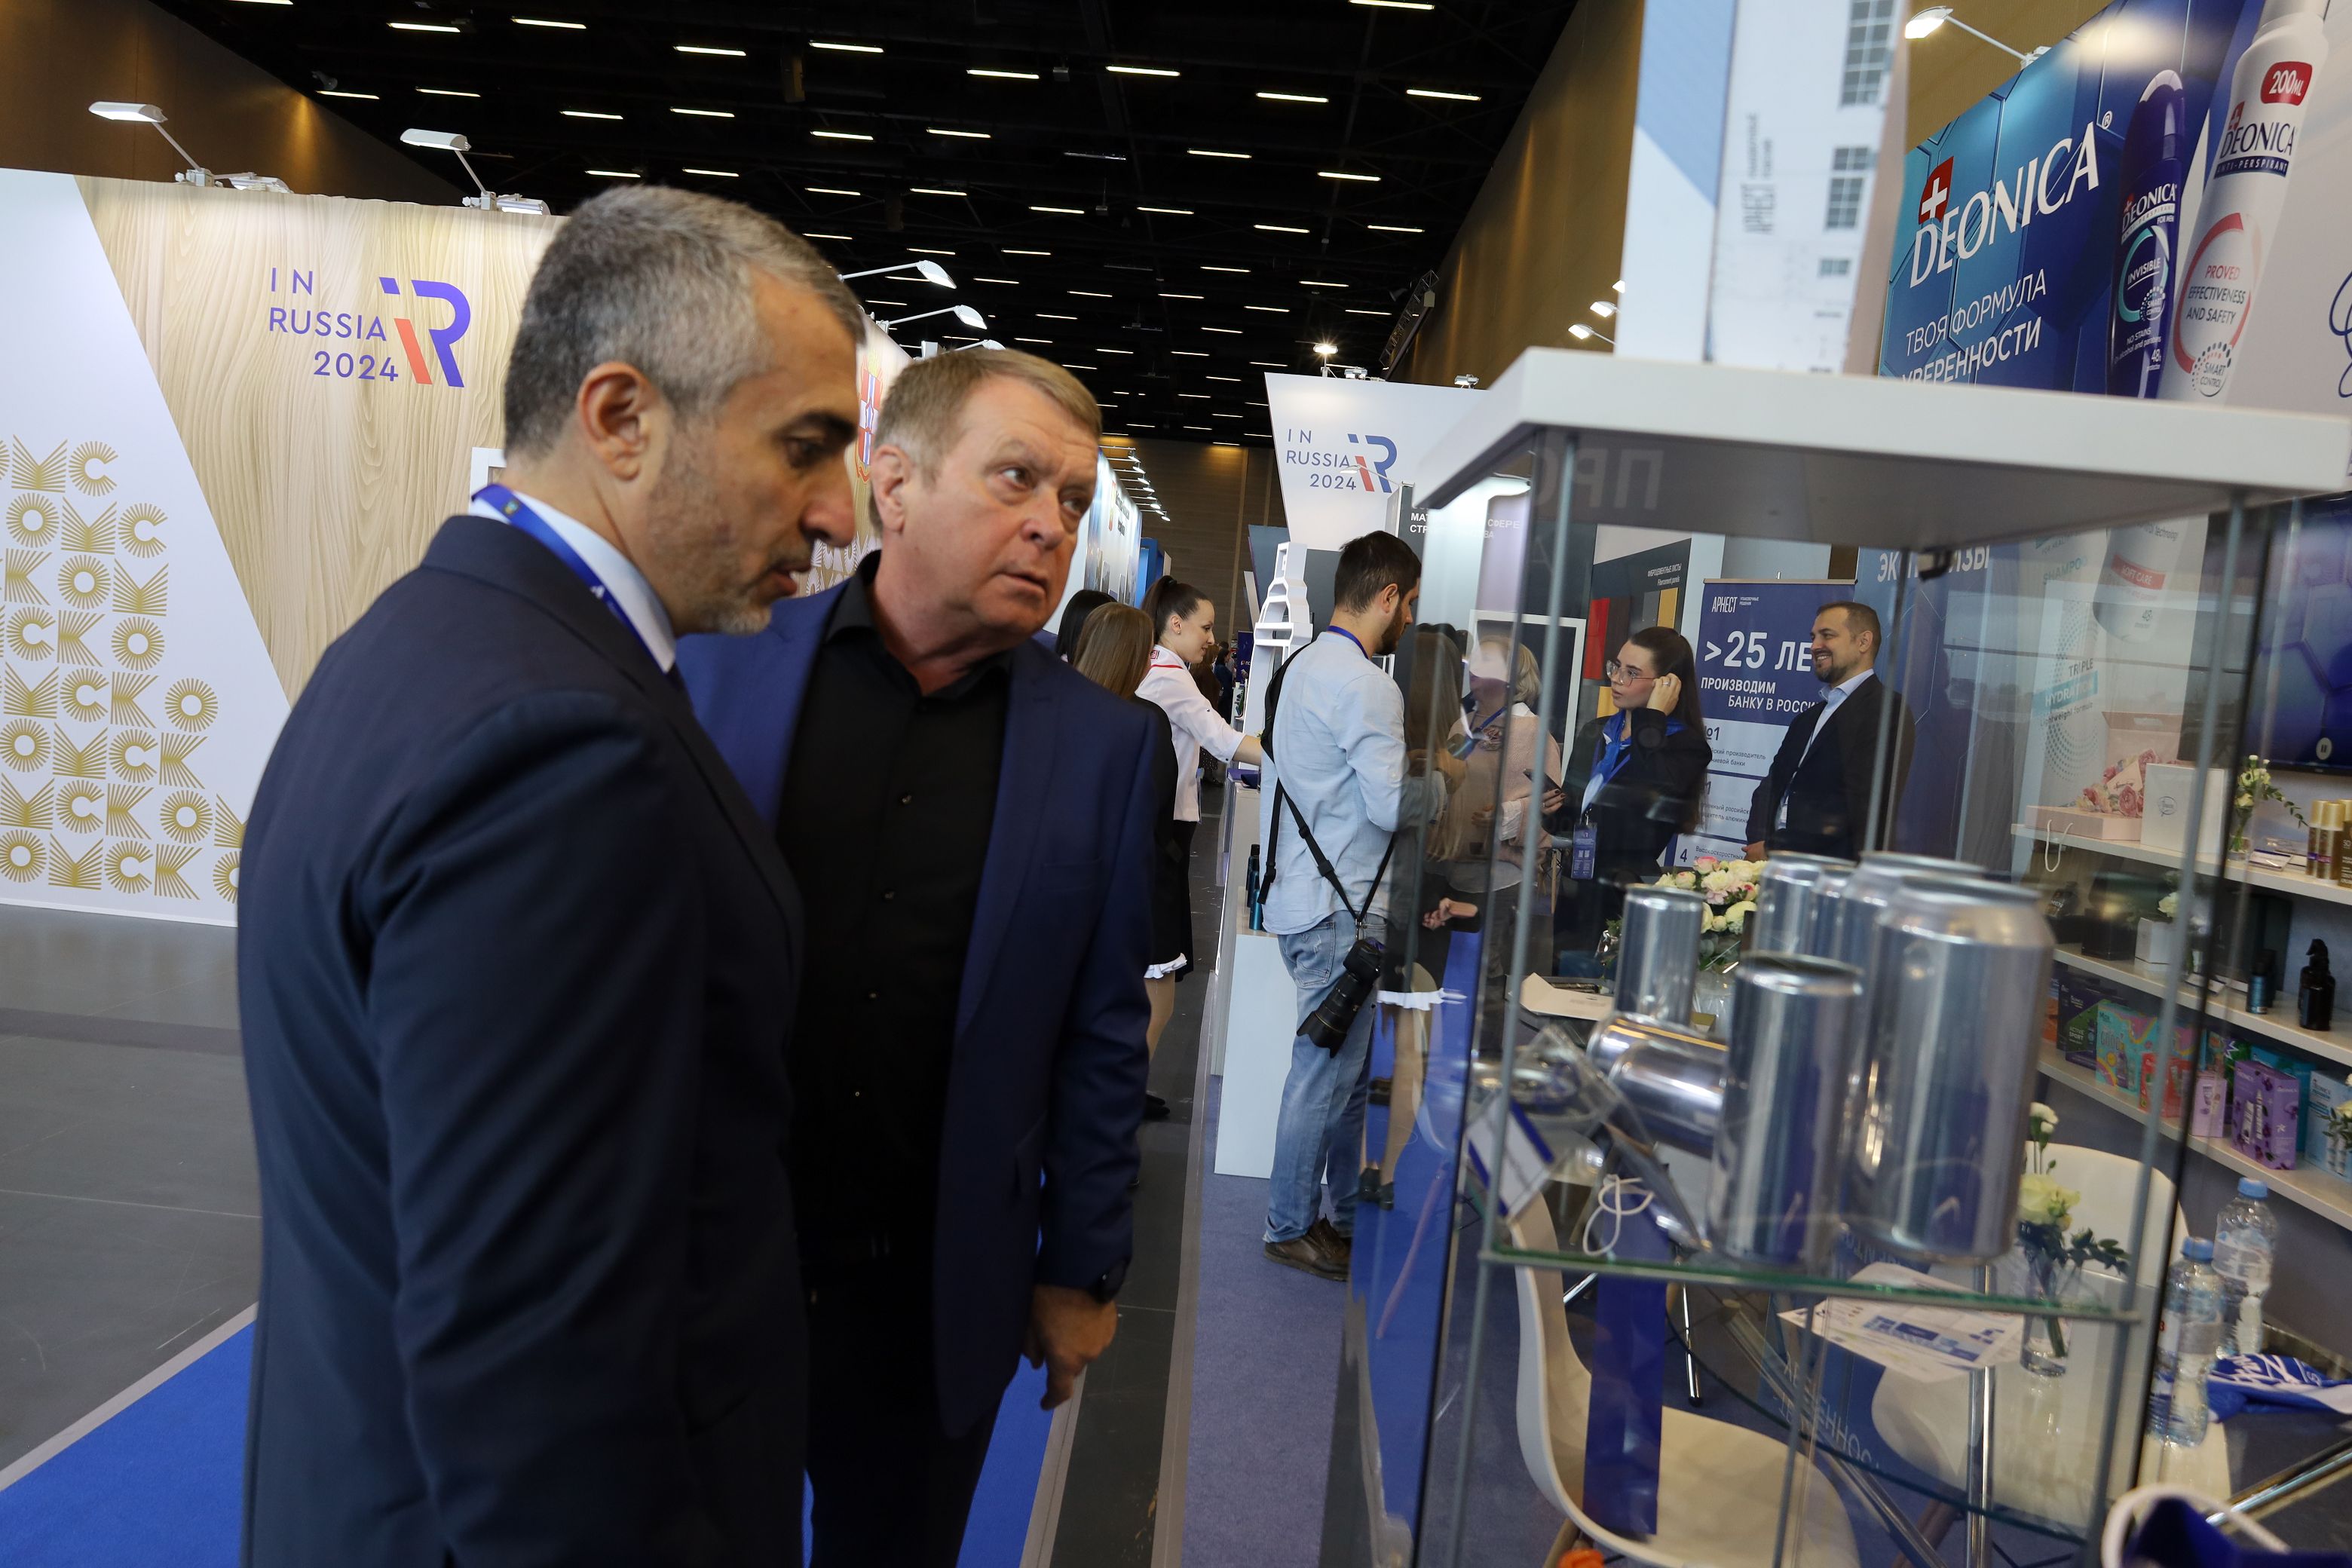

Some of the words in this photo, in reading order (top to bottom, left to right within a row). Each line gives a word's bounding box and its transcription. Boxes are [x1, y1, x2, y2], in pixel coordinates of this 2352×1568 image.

[2219, 121, 2296, 159] DEONICA
[1909, 121, 2099, 289] DEONICA
[2122, 182, 2176, 234] DEONICA
[2127, 257, 2161, 285] INVISIBLE
[2205, 265, 2240, 280] PROVED
[2188, 286, 2246, 305] EFFECTIVENESS
[1906, 314, 1948, 357] ТВОЯ
[1952, 268, 2047, 335] ФОРМУЛА
[2187, 307, 2206, 321] AND
[2206, 308, 2237, 326] SAFETY
[268, 307, 387, 342] RUSSIA
[313, 350, 399, 383] 2024
[2203, 362, 2226, 376] SMART
[1286, 450, 1351, 468] RUSSIA
[1309, 473, 1357, 491] 2024
[1711, 596, 1738, 613] АРНЕСТ
[1774, 641, 1813, 672] ЛЕ
[2069, 657, 2094, 677] TRIPLE
[1701, 677, 1776, 694] ПРОИЗВОДИМ
[1728, 695, 1764, 709] БАНКУ
[1766, 698, 1773, 711] В
[1776, 699, 1819, 713] РОССИ
[1726, 749, 1766, 761] производитель
[1730, 758, 1746, 767] банки
[1725, 805, 1750, 815] российск
[1725, 815, 1748, 824] алюмин
[1680, 848, 1688, 863] 4
